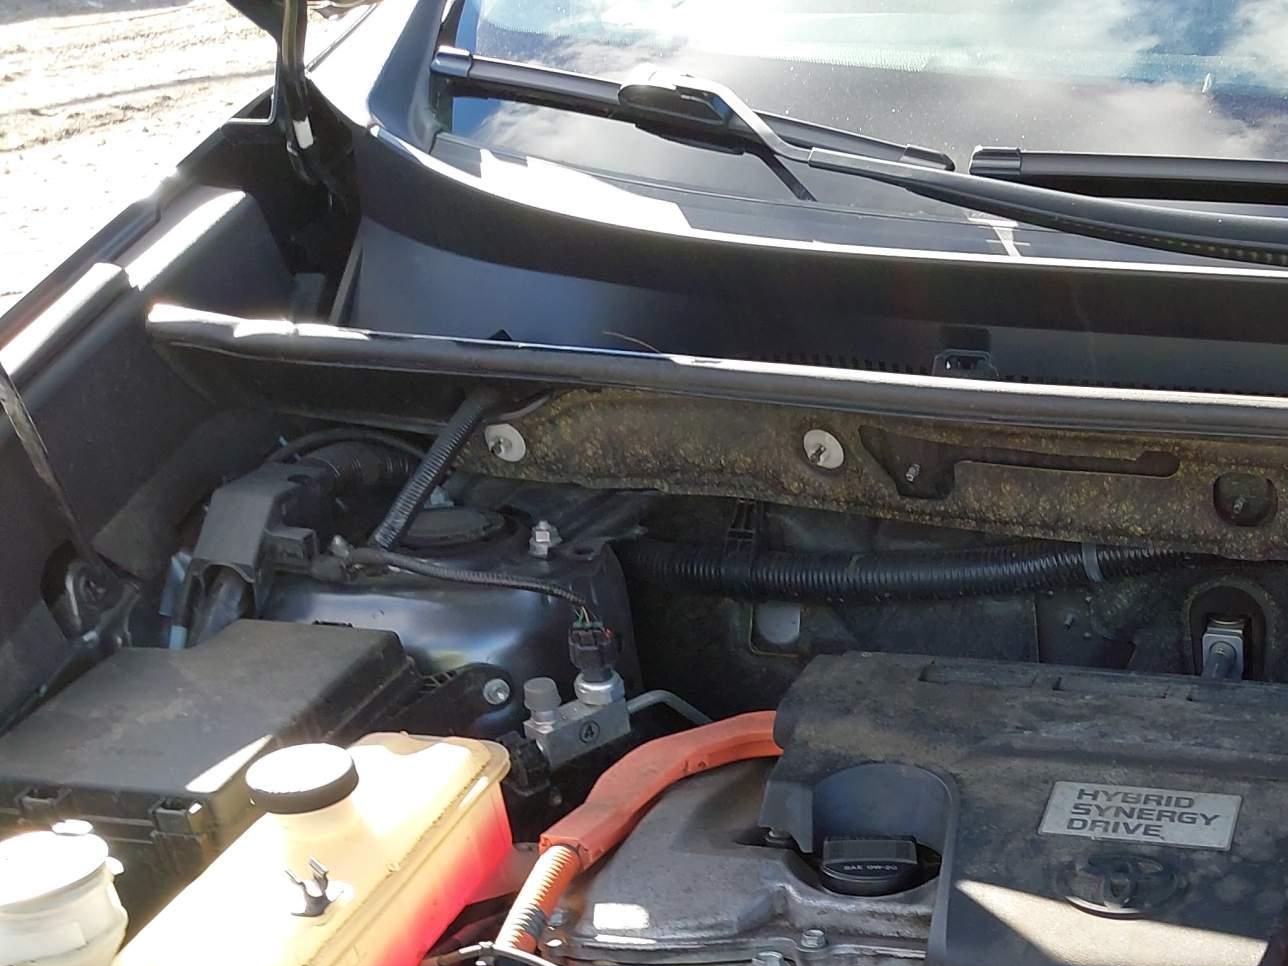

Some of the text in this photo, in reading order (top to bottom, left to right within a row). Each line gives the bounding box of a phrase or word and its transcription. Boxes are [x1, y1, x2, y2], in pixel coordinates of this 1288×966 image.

[1076, 788, 1195, 809] HYBRID
[1071, 803, 1220, 826] SYNERGY
[1066, 818, 1164, 838] DRIVE
